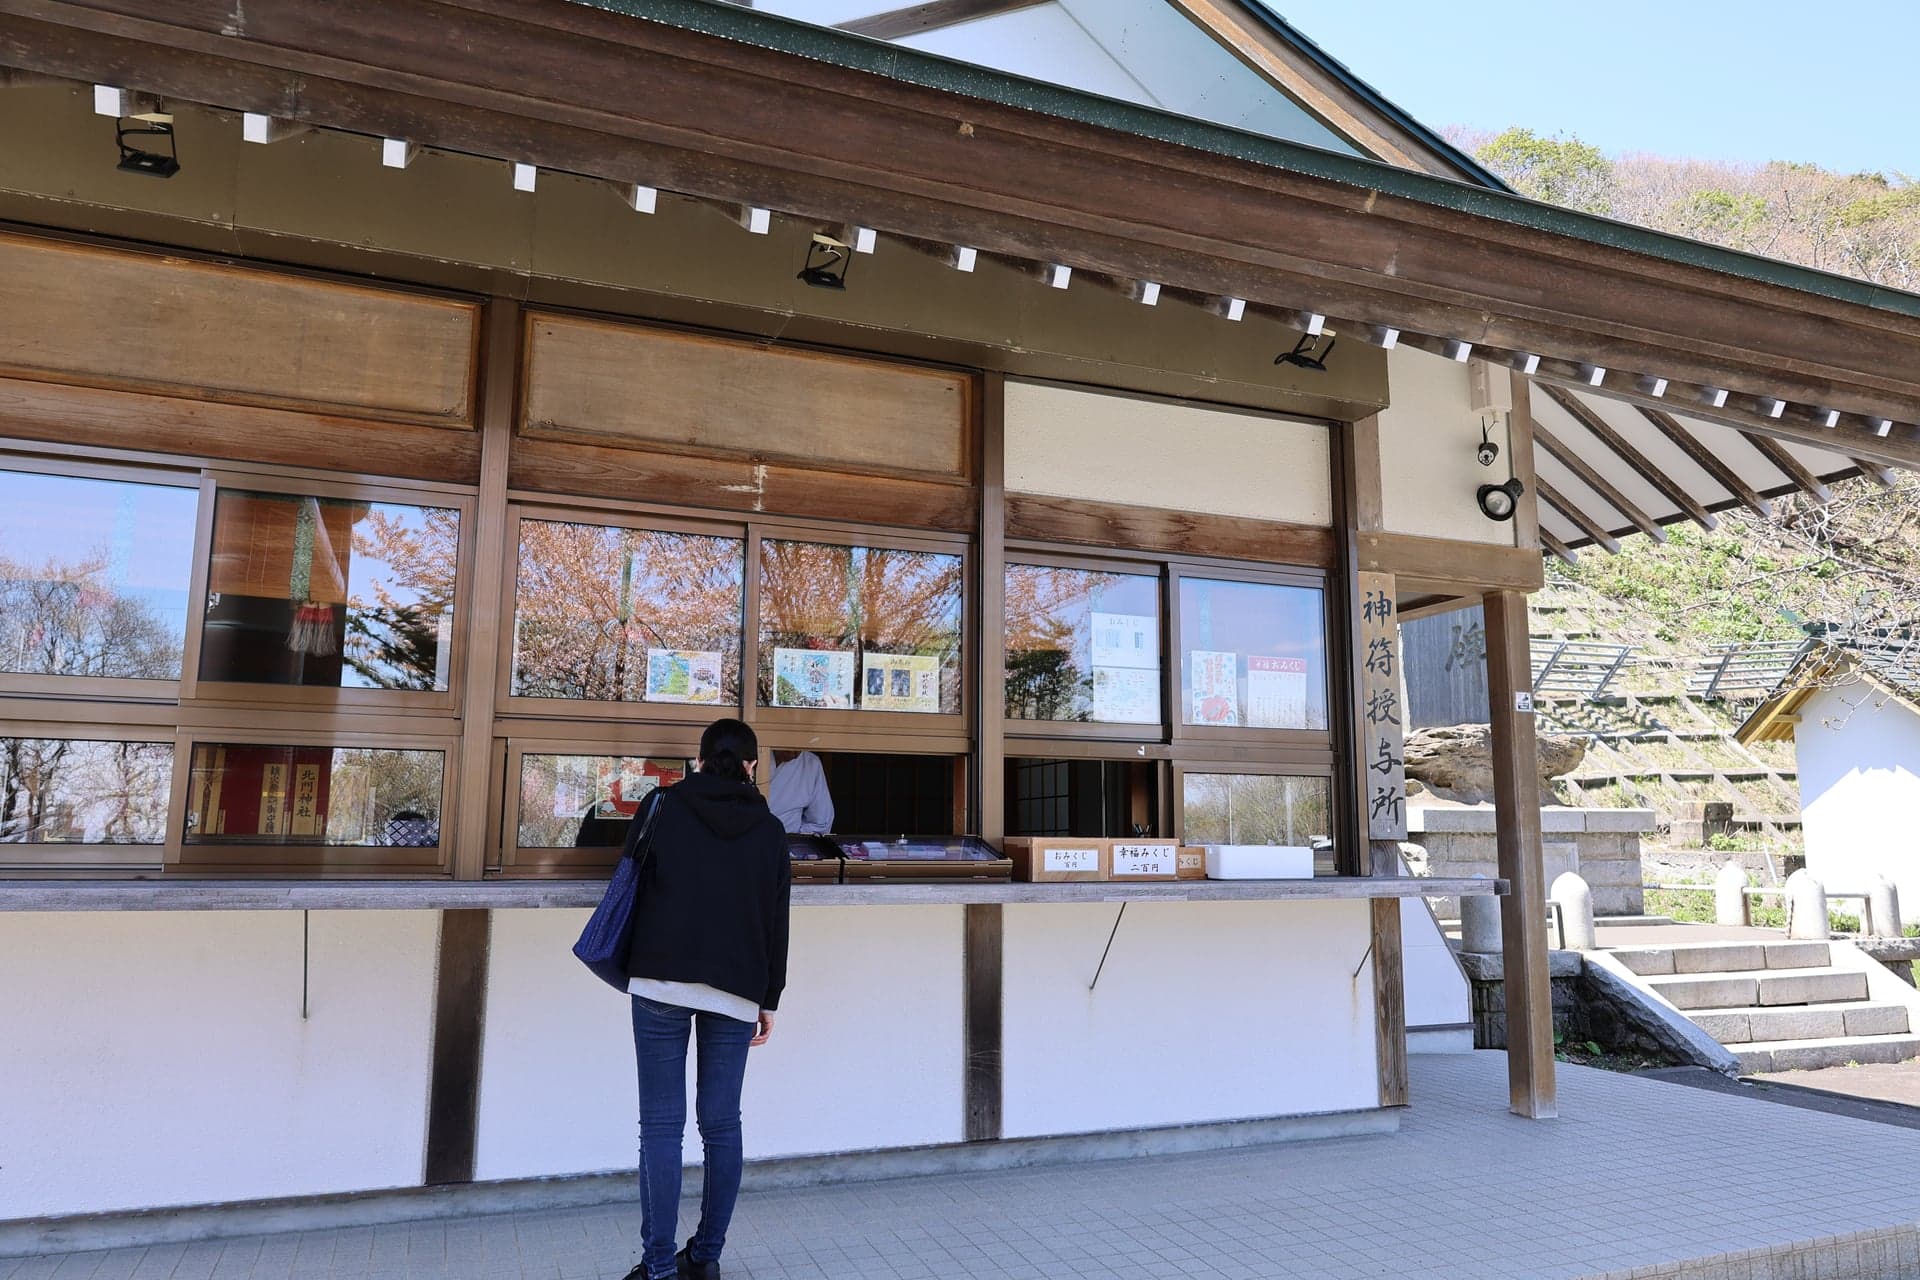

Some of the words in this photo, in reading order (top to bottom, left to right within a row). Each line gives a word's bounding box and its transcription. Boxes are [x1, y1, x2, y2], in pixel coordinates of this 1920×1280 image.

[1363, 591, 1404, 825] 神符授与所
[296, 769, 316, 818] 北門神社
[1055, 851, 1088, 860] おみくじ
[1119, 847, 1170, 859] 幸福みくじ
[1130, 863, 1160, 873] 二百円
